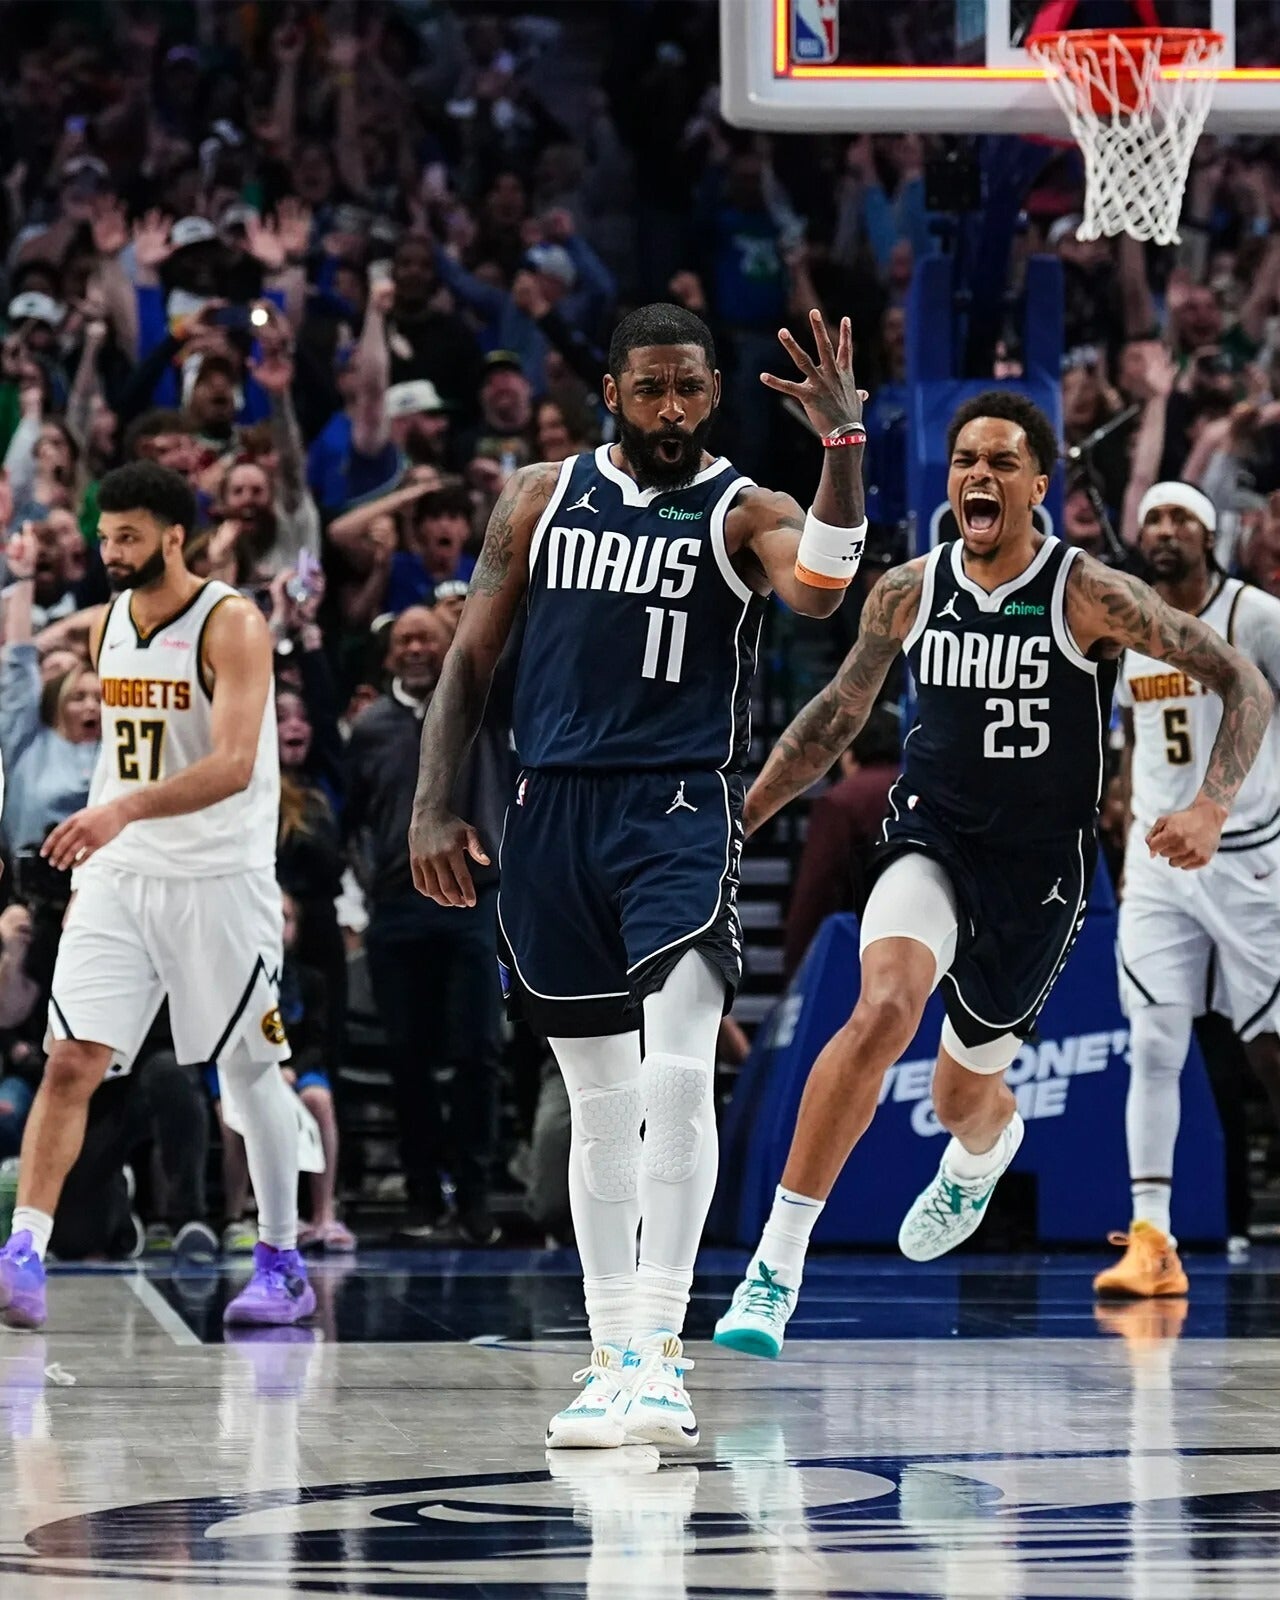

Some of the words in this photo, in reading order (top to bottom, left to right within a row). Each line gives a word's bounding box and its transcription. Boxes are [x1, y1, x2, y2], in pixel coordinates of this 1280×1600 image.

[830, 437, 846, 446] KAI
[658, 506, 703, 521] chime
[547, 526, 702, 599] MAVS
[1004, 601, 1045, 616] chime
[641, 606, 688, 683] 11
[919, 629, 1050, 690] MAVS
[101, 677, 191, 711] NUGGETS
[1129, 672, 1208, 702] NUGGE
[115, 718, 166, 782] 27
[983, 697, 1050, 759] 25
[1163, 707, 1193, 766] 5
